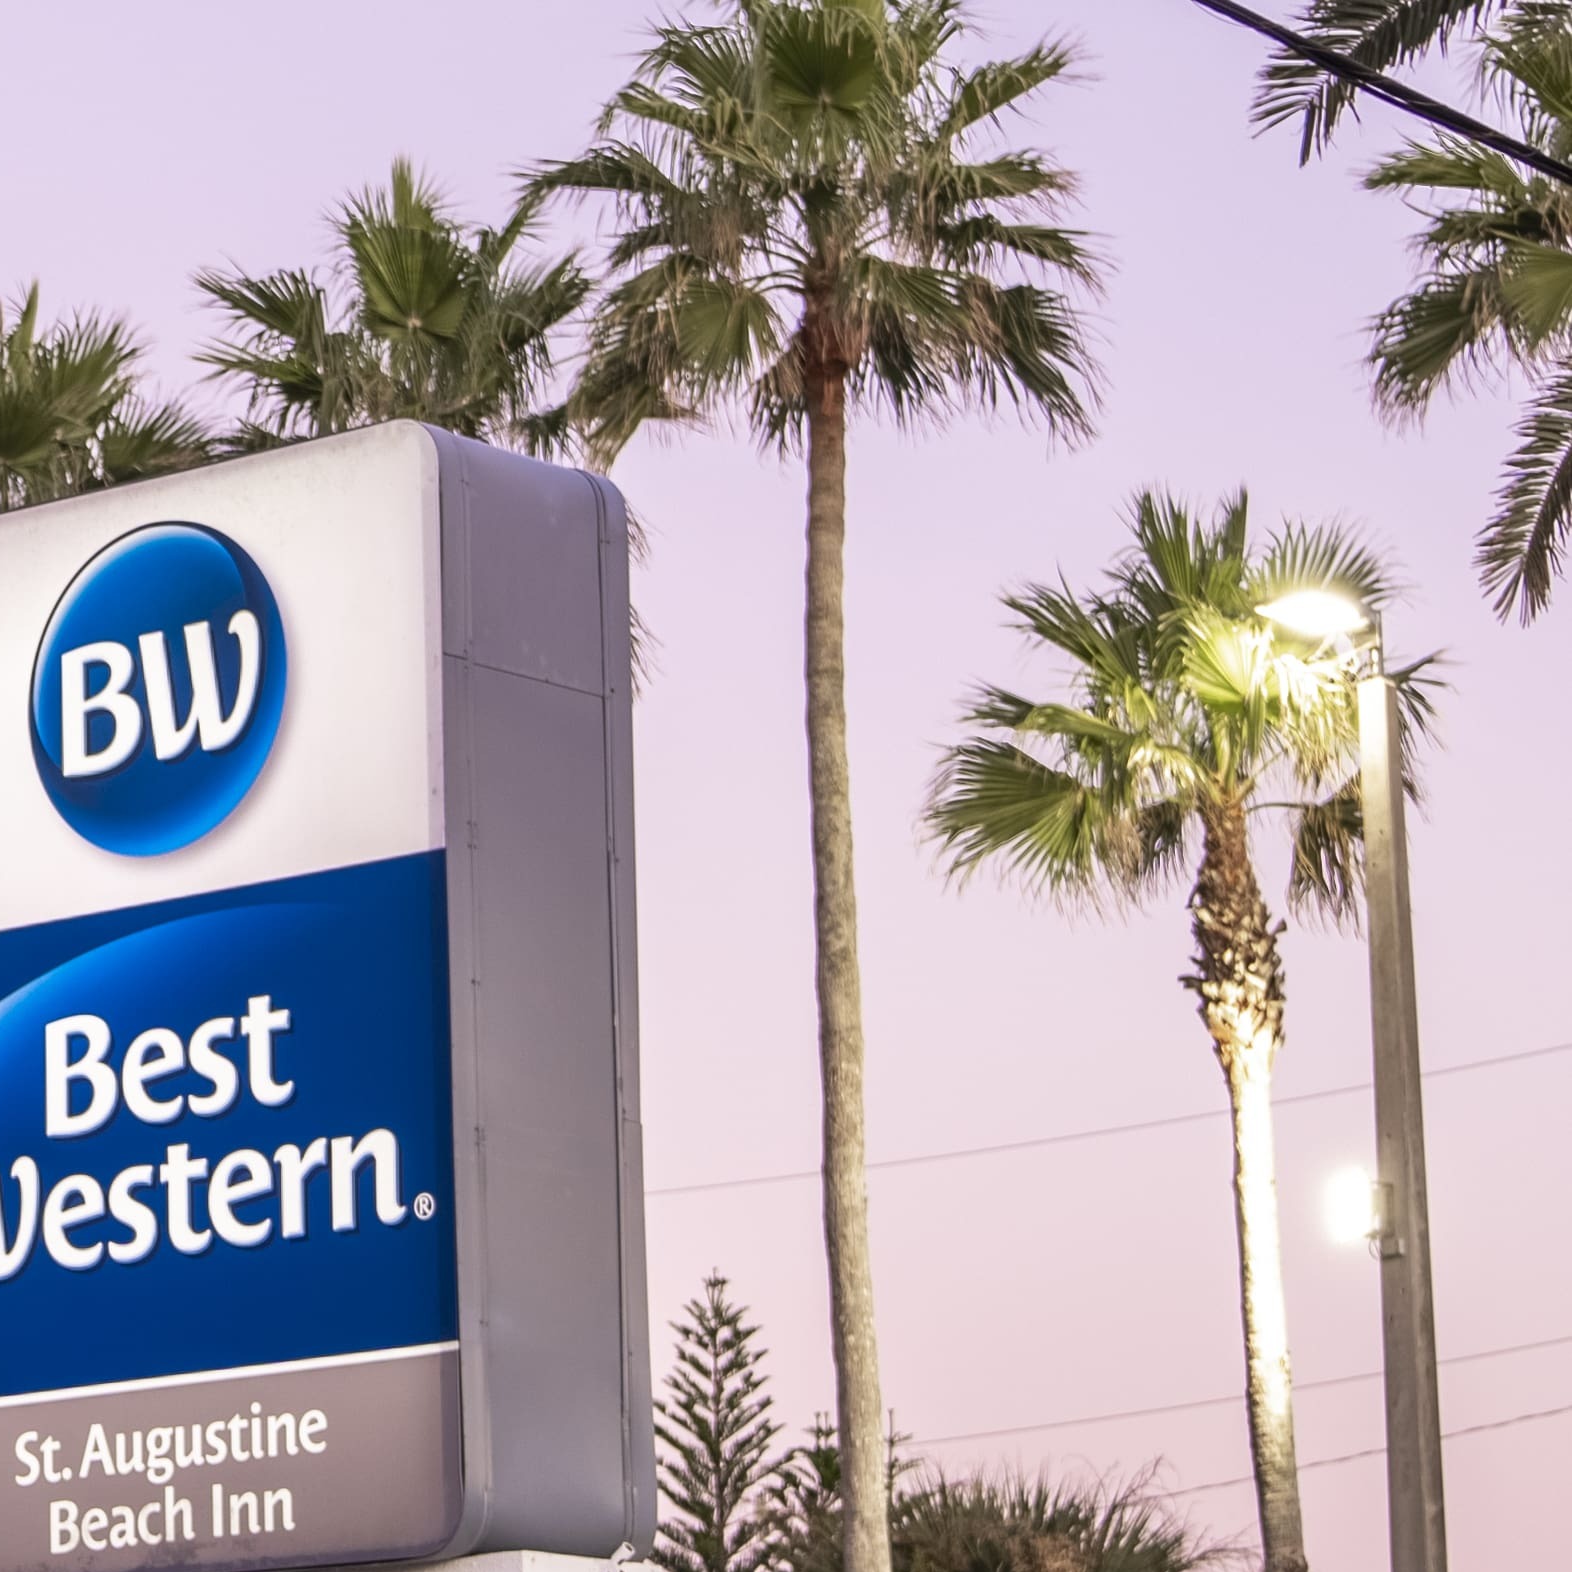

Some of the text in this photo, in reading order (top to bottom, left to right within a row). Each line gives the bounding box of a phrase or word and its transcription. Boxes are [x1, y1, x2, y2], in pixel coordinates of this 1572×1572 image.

[59, 608, 261, 779] BW
[44, 994, 294, 1138] Best
[13, 1401, 329, 1488] St. Augustine
[48, 1482, 297, 1556] Beach Inn
